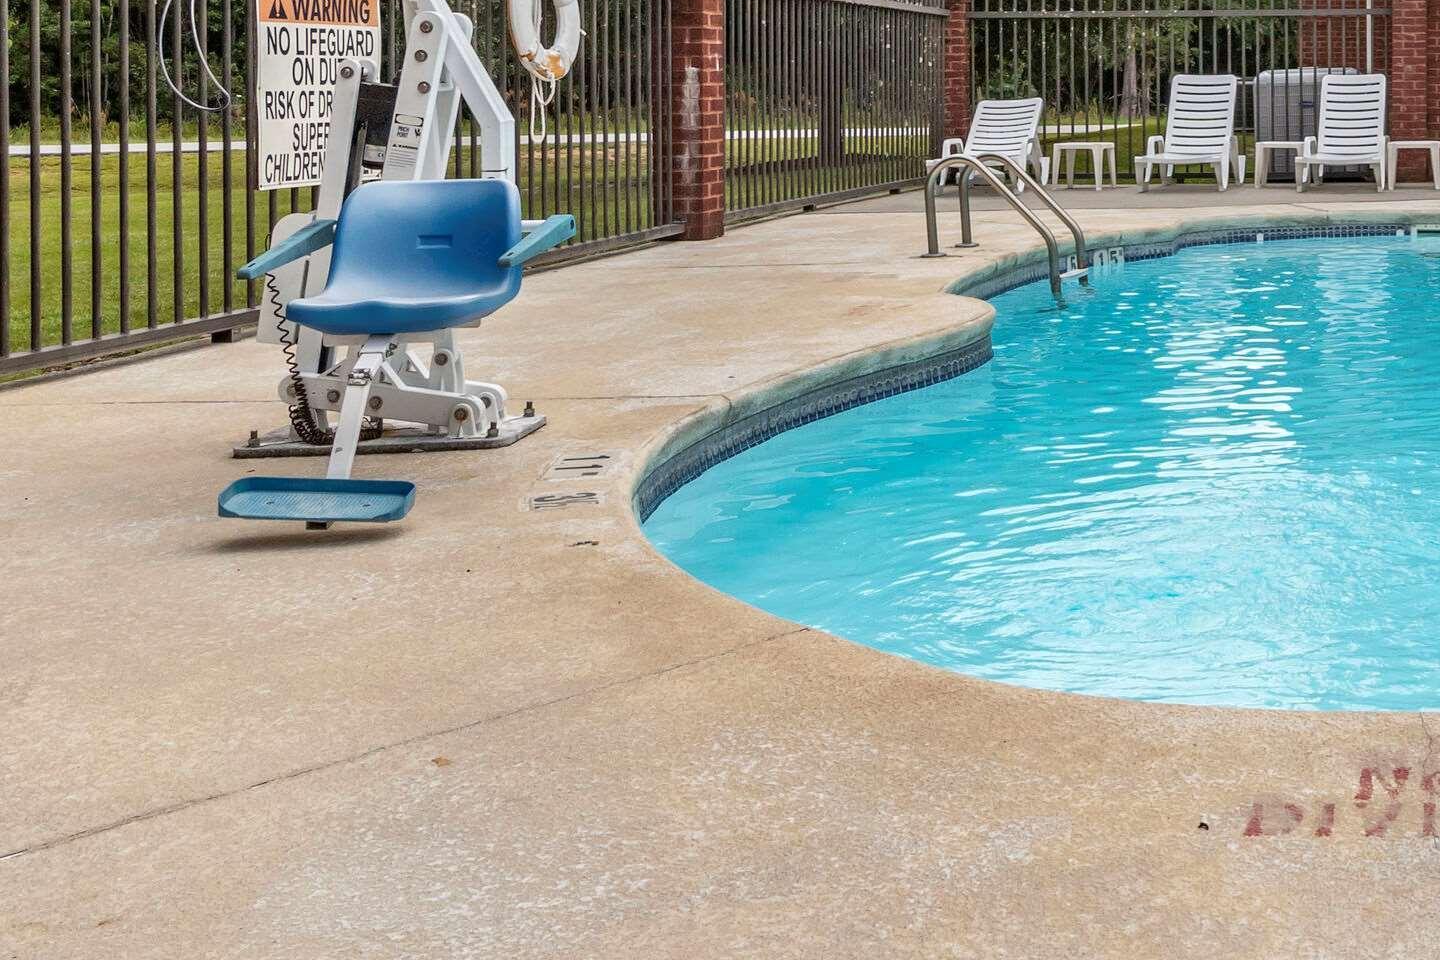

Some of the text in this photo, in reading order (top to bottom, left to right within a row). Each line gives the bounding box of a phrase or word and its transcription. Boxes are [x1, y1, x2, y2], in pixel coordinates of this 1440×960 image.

[267, 26, 374, 57] NO LIFEGUARD
[292, 57, 344, 86] ON DU
[265, 90, 295, 120] RISK
[299, 90, 314, 119] OF
